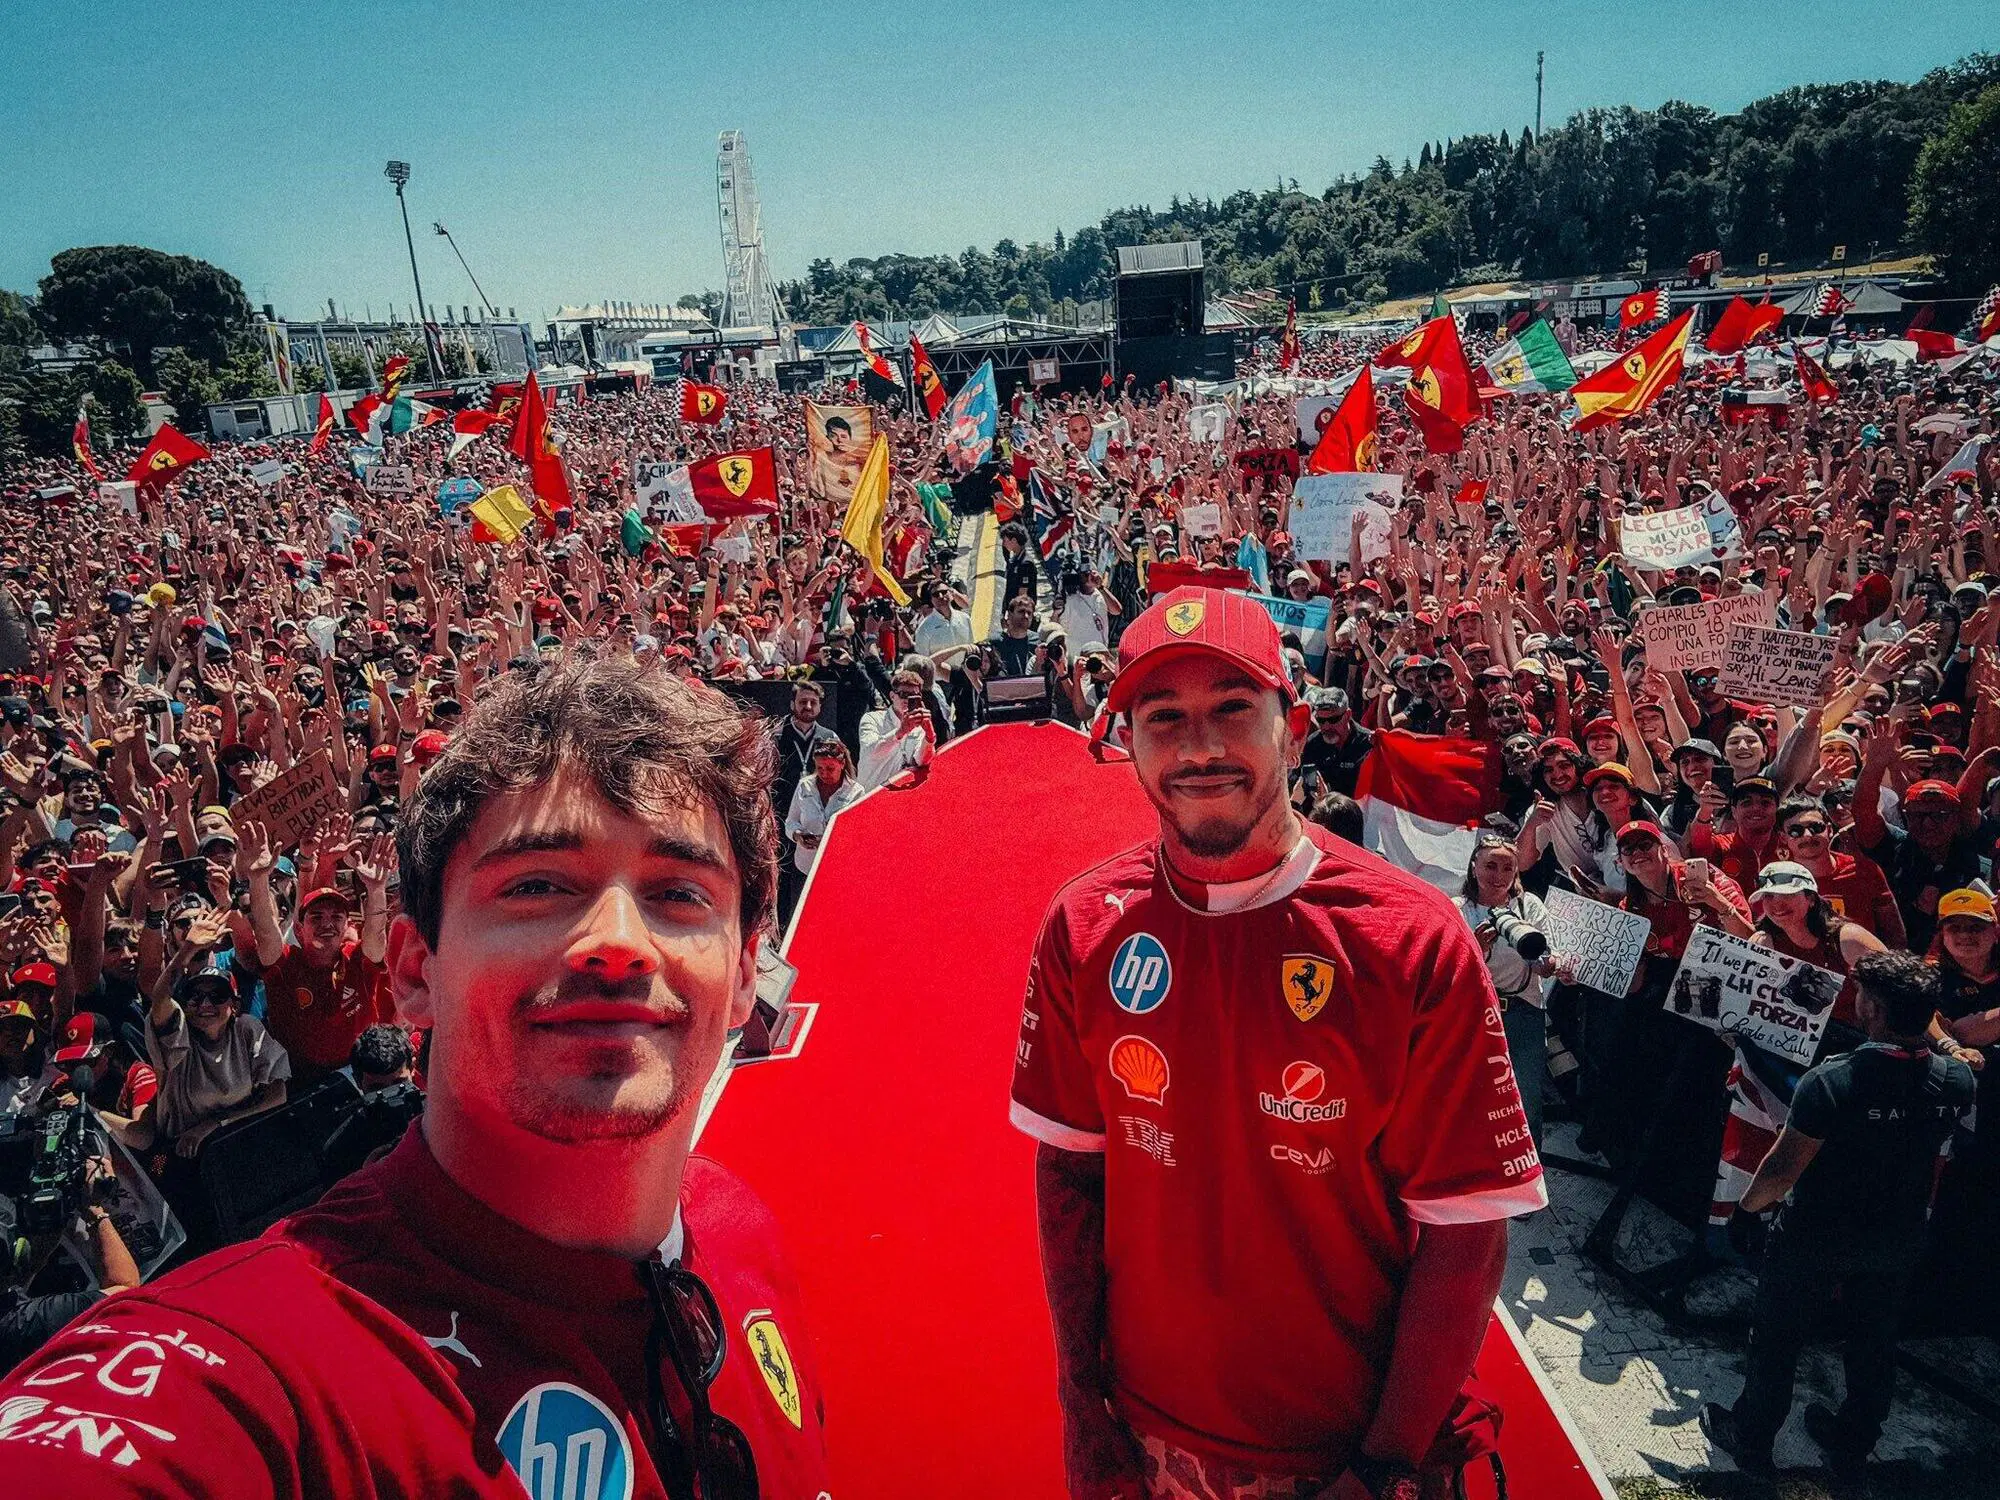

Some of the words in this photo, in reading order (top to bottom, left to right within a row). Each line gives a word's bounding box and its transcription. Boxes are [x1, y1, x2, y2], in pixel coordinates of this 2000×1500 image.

[1622, 493, 1726, 533] LECLERC
[1669, 521, 1706, 539] VUOI
[1262, 600, 1308, 621] AMOS
[1644, 604, 1707, 626] CHARLES
[1712, 594, 1767, 616] DOMANI
[1648, 622, 1697, 642] COMPIO
[1704, 616, 1725, 634] 18
[1675, 639, 1704, 652] UNA
[1708, 632, 1729, 646] FO
[1734, 625, 1757, 641] I'VE
[1761, 630, 1800, 646] WAITED
[1818, 639, 1837, 652] YRS
[1669, 649, 1724, 669] INSIEM
[1728, 650, 1764, 666] TODAY
[1765, 656, 1770, 667] I
[1772, 657, 1792, 668] CAN
[1731, 640, 1752, 652] FOR
[1758, 643, 1781, 656] THIS
[1783, 647, 1819, 660] MOMENT
[267, 772, 326, 820] BIRTHDAY
[1585, 904, 1641, 942] ROCK
[1697, 925, 1728, 940] TODAY
[1728, 936, 1750, 949] I'M
[1566, 928, 1641, 973] SCISSORS
[1115, 934, 1164, 1013] hp
[1725, 973, 1753, 996] LH
[1747, 1000, 1808, 1033] FORZA
[1261, 1093, 1345, 1121] UniCredit
[1867, 1105, 1961, 1121] SATY
[1118, 1115, 1177, 1167] IBM
